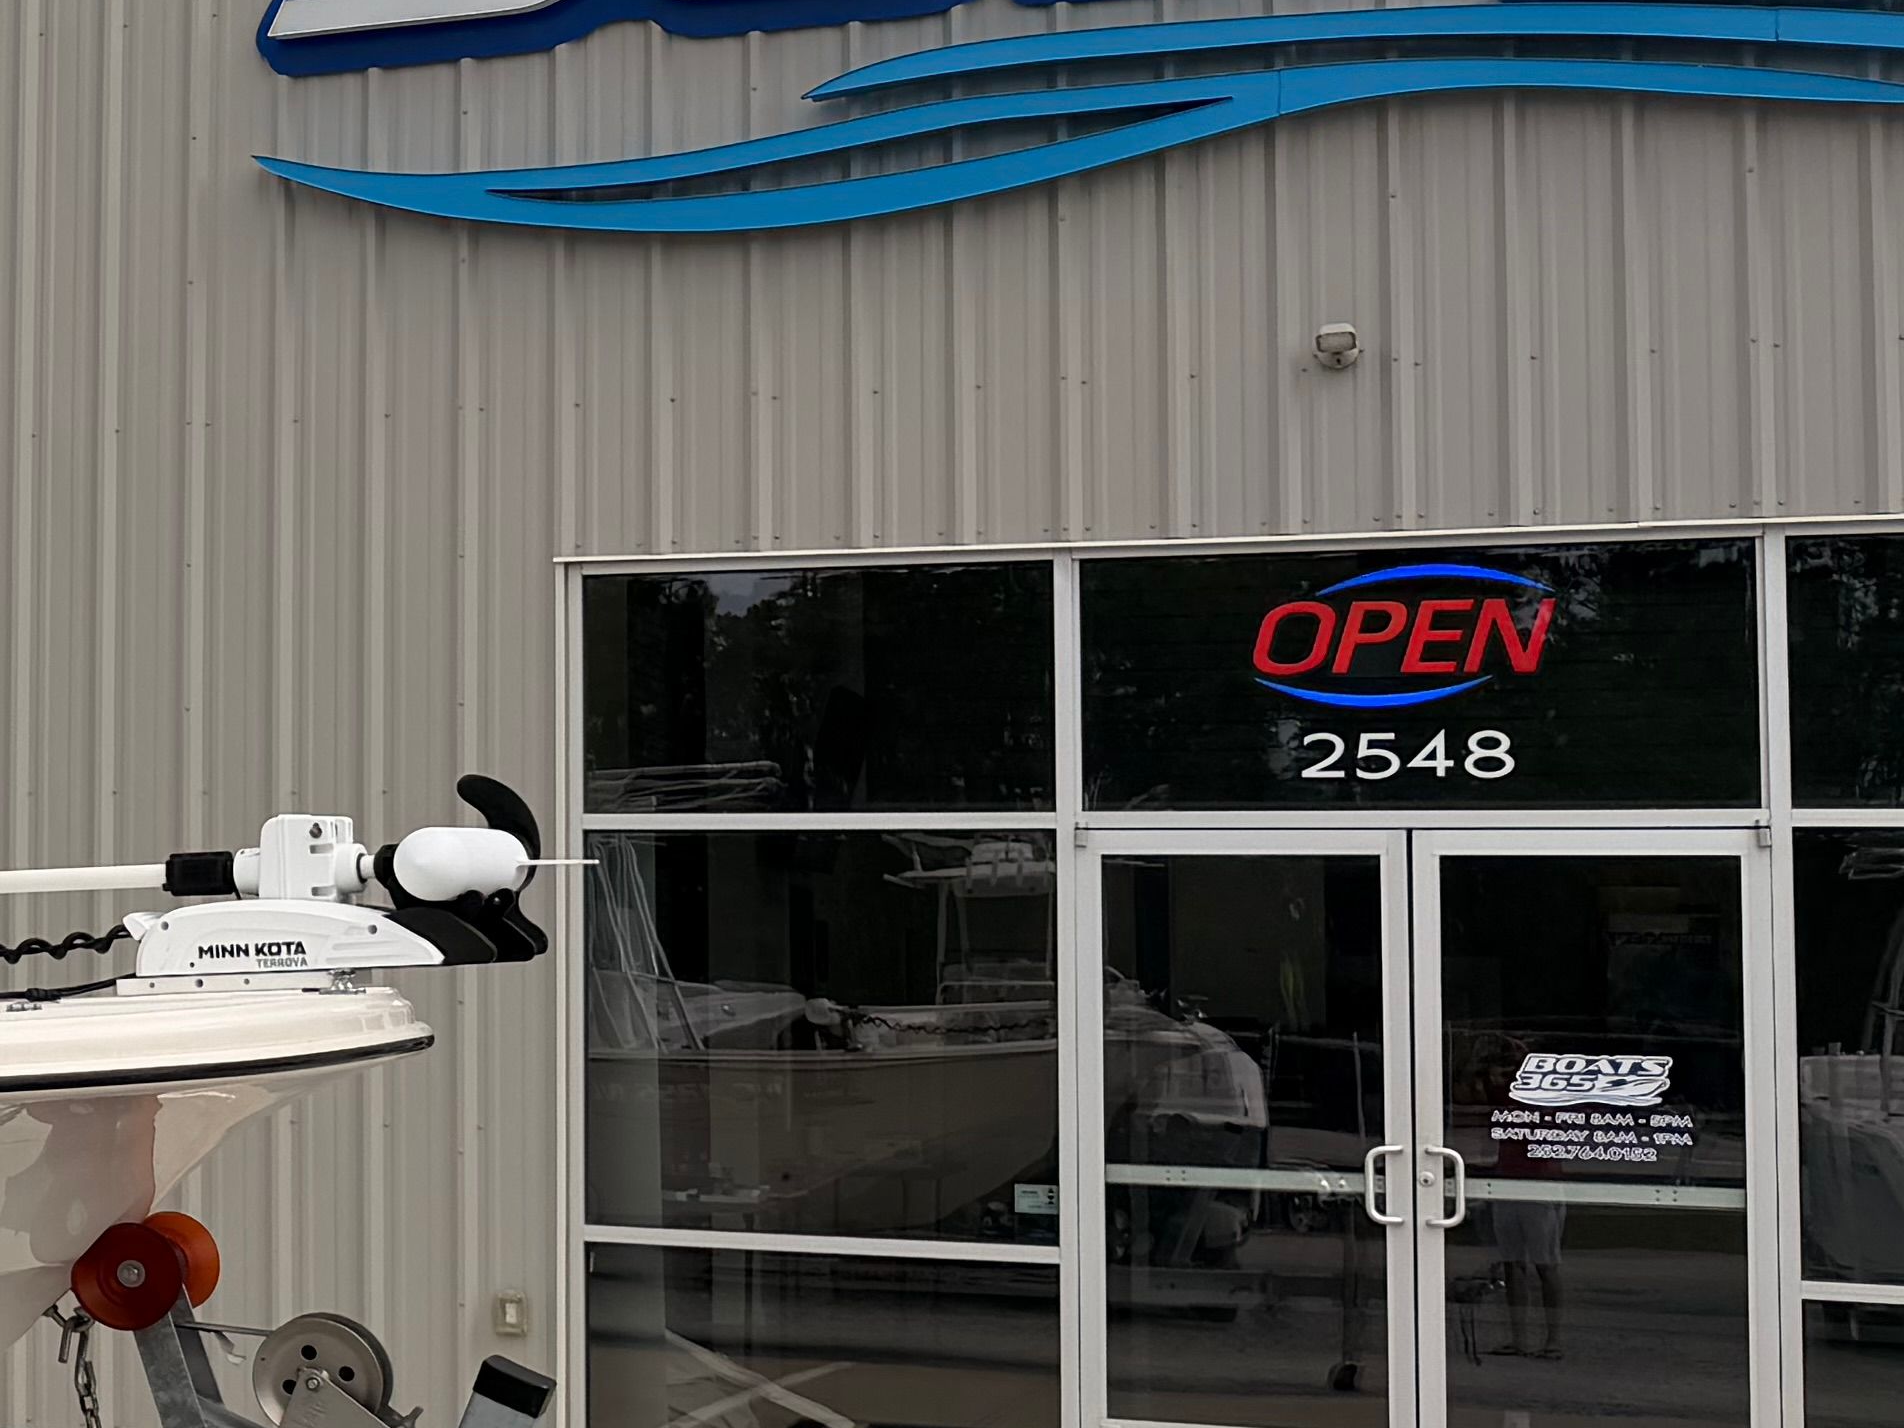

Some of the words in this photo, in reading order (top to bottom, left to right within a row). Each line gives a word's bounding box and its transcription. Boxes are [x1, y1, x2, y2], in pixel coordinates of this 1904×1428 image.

[1252, 597, 1557, 675] OPEN
[1301, 728, 1516, 780] 2548
[197, 943, 250, 959] MINN
[254, 941, 307, 957] KOTA
[256, 956, 308, 969] TERROVA
[1522, 1056, 1668, 1075] BOATS
[1514, 1073, 1598, 1090] 365
[1491, 1127, 1590, 1142] SATURDAY
